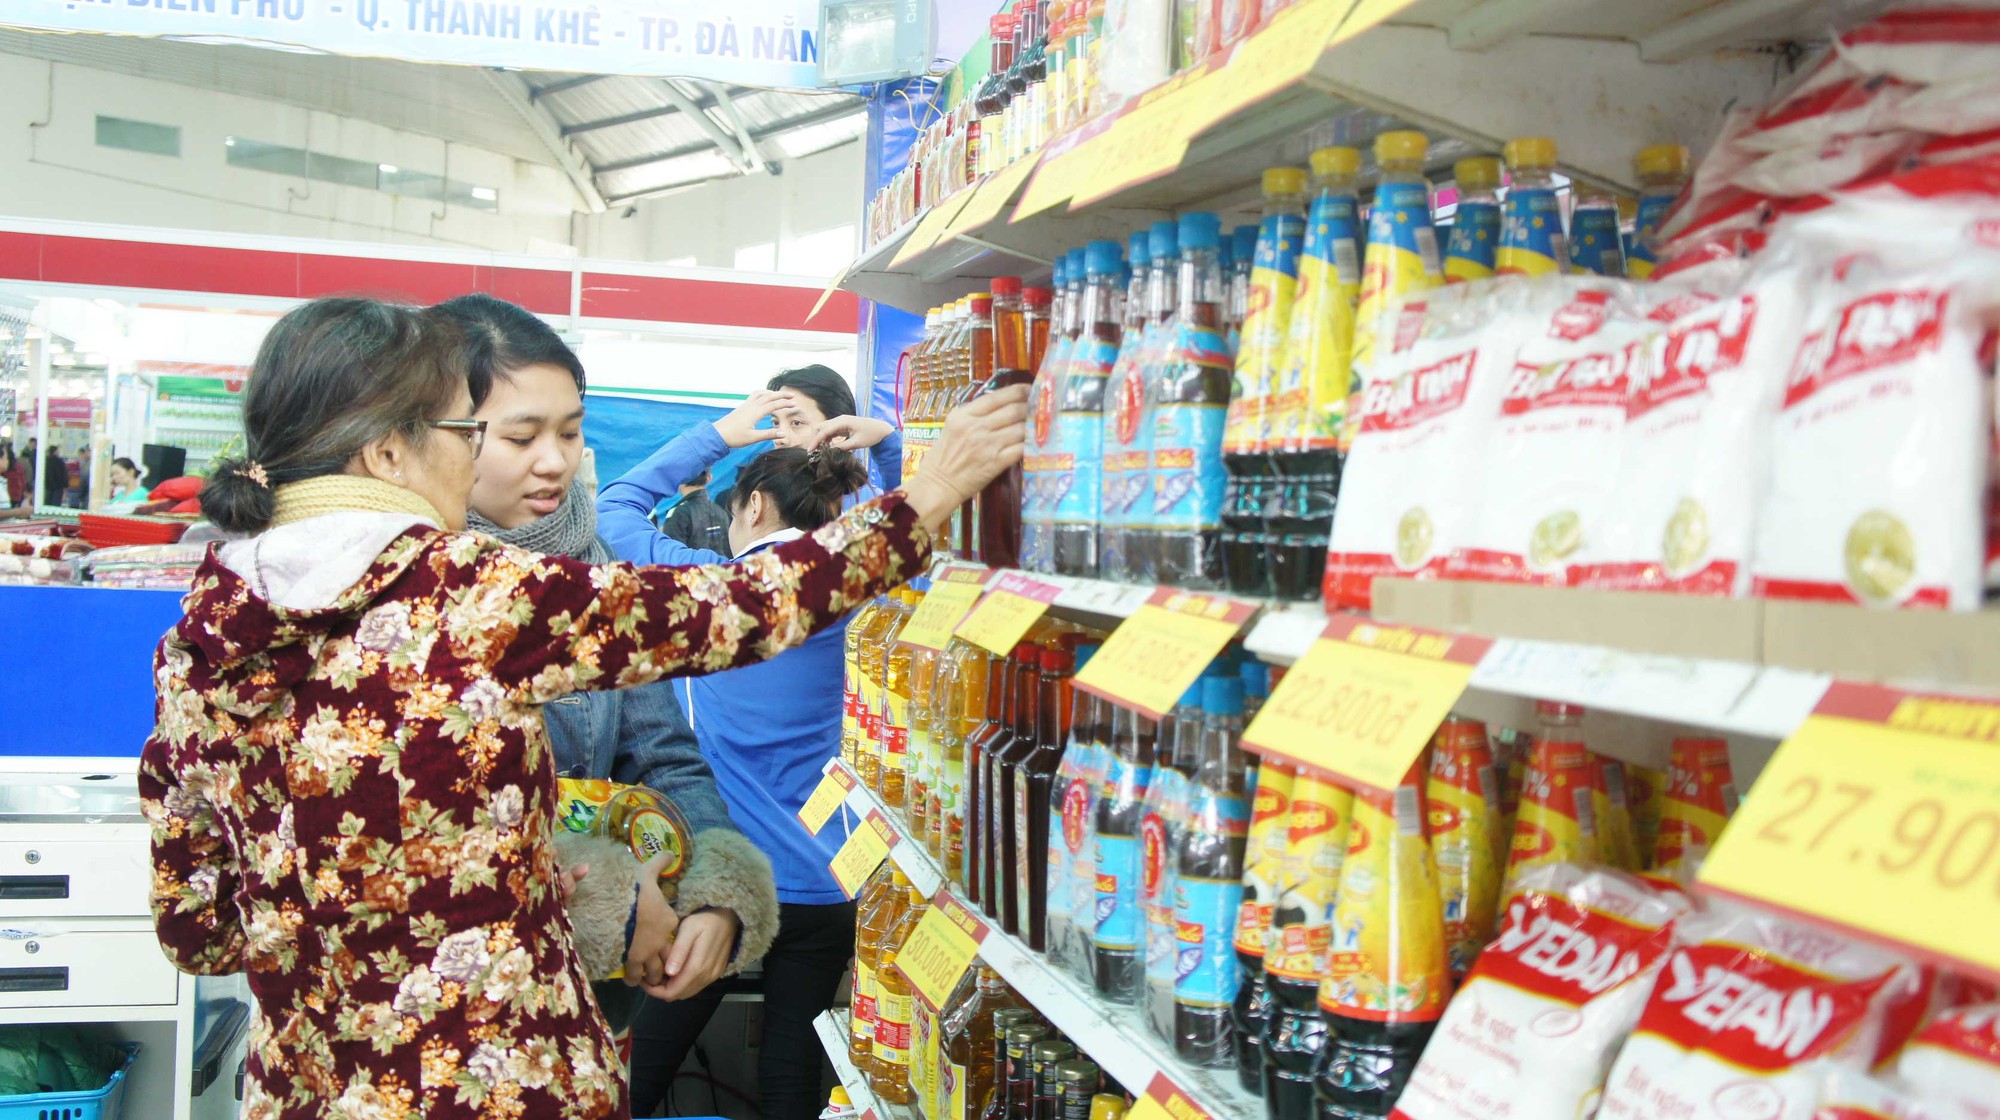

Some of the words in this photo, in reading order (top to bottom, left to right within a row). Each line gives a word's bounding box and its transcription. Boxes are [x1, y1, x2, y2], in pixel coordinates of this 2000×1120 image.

[356, 0, 390, 32] Q.
[407, 0, 521, 40] THANH
[534, 4, 601, 47] KHÊ
[638, 16, 683, 53] TP.
[694, 15, 740, 58] ĐÀ
[1274, 673, 1418, 747] 22.800đ
[1756, 775, 2000, 898] 27.90
[906, 930, 960, 992] 30.000đ
